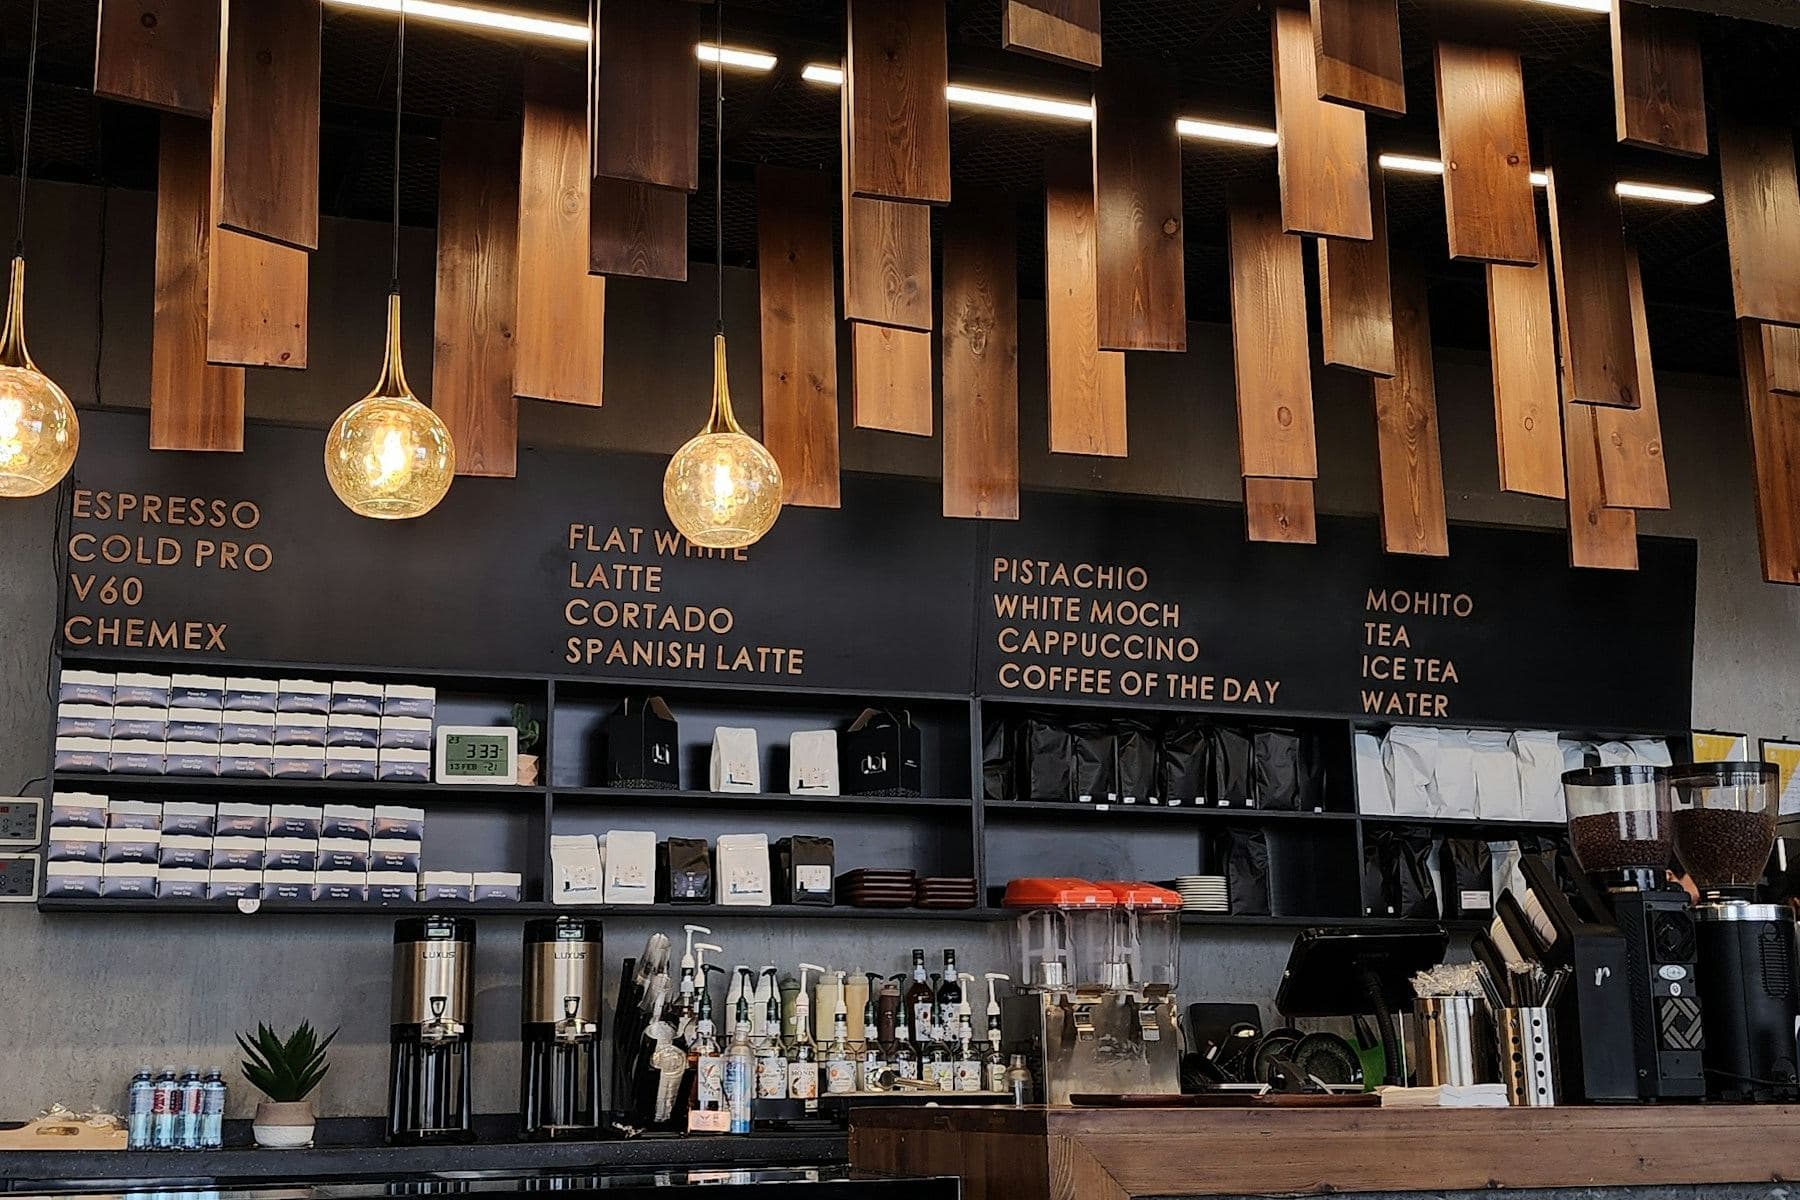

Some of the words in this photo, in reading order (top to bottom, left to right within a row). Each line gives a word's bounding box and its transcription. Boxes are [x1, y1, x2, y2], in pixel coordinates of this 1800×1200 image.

[72, 489, 261, 529] ESPRESSO
[68, 533, 182, 565] COLD
[195, 539, 273, 572] PRO
[569, 523, 645, 555] FLAT
[70, 573, 143, 606] V60
[570, 562, 662, 593] LATTE
[993, 557, 1148, 592] PISTACHIO
[565, 598, 734, 634] CORTADO
[994, 594, 1081, 622] WHITE
[1089, 599, 1179, 627] MOCH
[1366, 590, 1473, 617] MOHITO
[64, 615, 226, 651] CHEMEX
[997, 627, 1199, 663] CAPPUCCINO
[1365, 622, 1410, 647] TEA
[565, 636, 706, 669] SPANISH
[716, 645, 804, 675] LATTE
[1362, 655, 1407, 681] ICE
[1414, 658, 1457, 683] TEA
[998, 662, 1111, 694] COFFEE
[1119, 670, 1158, 696] OF
[1167, 673, 1214, 701] THE
[1222, 677, 1280, 704] DAY
[1361, 690, 1449, 717] WATER
[422, 951, 456, 960] LUXUS
[554, 951, 587, 960] LUXUS
